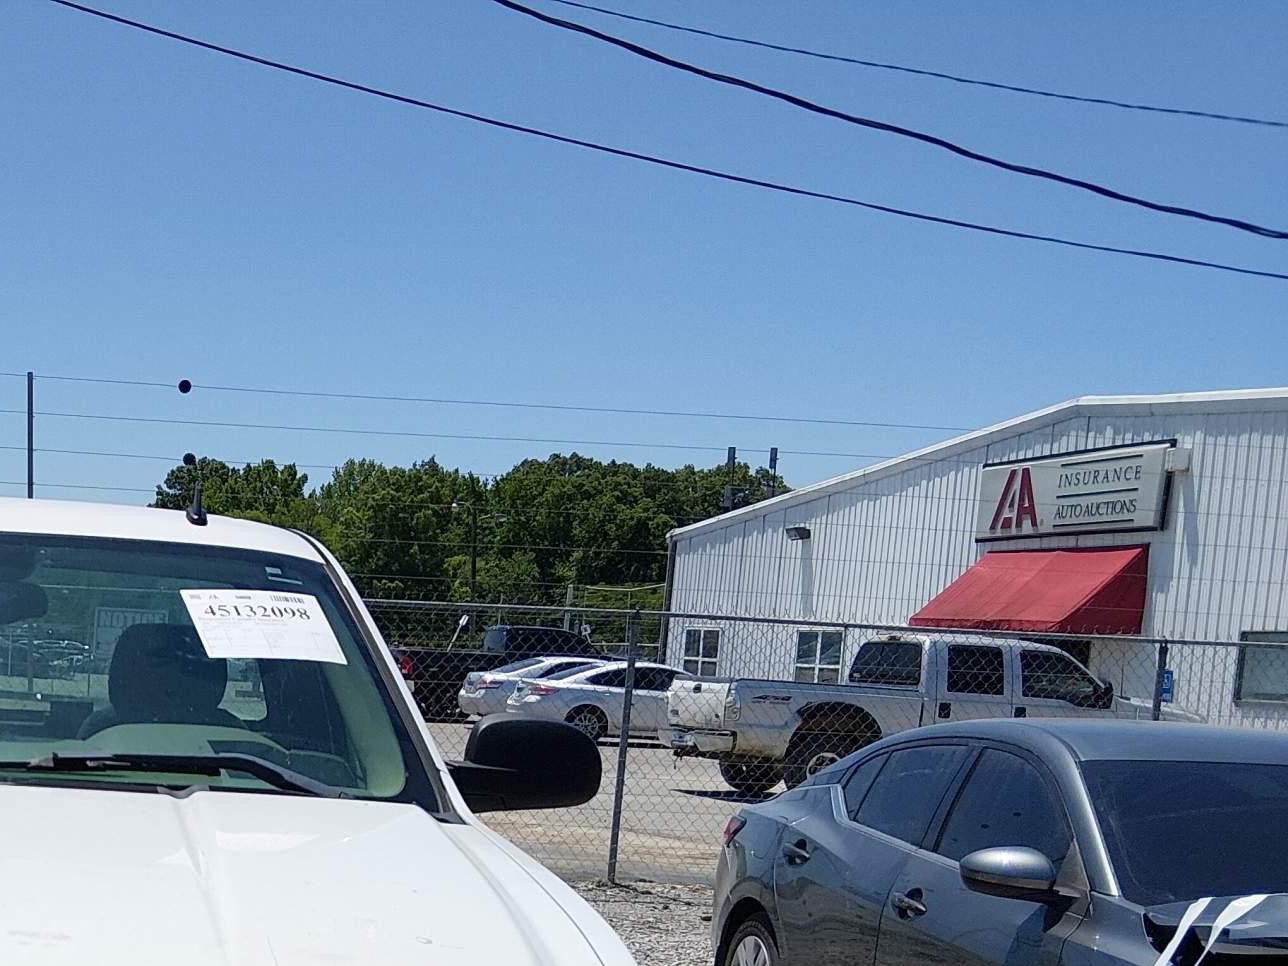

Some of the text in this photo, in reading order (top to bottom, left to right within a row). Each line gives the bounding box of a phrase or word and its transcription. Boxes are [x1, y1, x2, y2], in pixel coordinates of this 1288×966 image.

[1058, 465, 1142, 488] INSURANCE
[1054, 499, 1136, 519] AUTO AUCTIONS
[204, 604, 311, 620] 45132098
